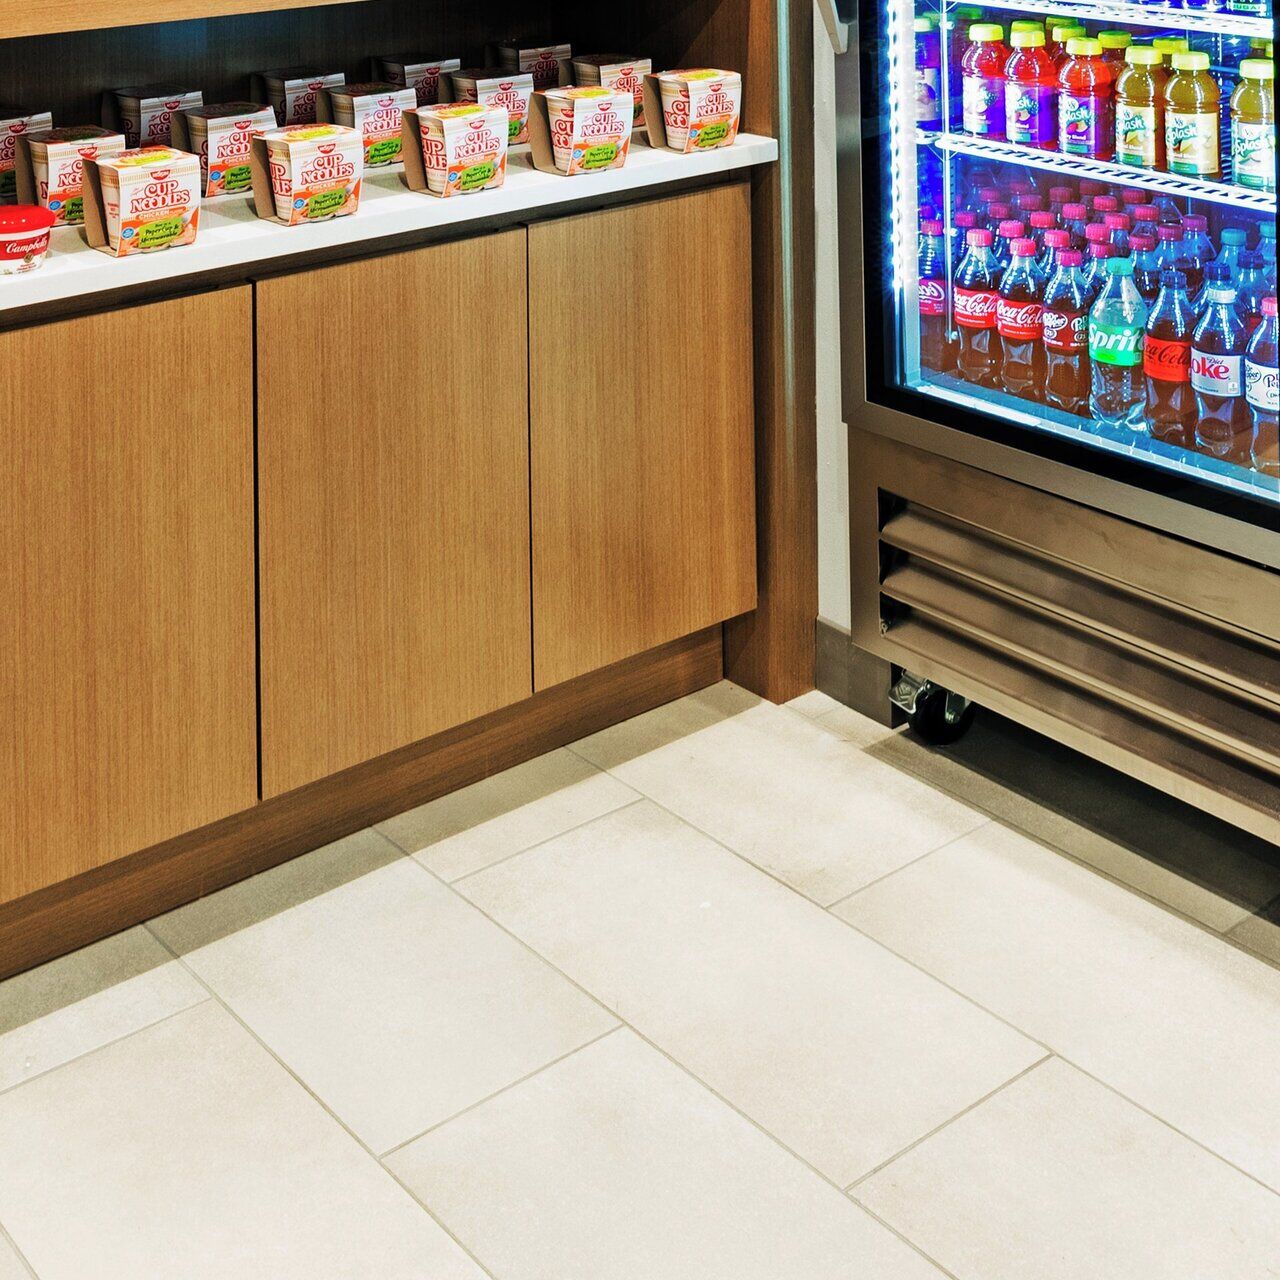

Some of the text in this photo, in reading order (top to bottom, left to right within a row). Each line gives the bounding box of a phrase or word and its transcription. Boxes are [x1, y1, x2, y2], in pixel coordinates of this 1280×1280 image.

[616, 75, 638, 88] CUP
[494, 90, 518, 104] CUP
[705, 92, 727, 104] CUP
[373, 107, 400, 121] CUP
[696, 100, 734, 118] NOODLES
[592, 111, 617, 124] CUP
[465, 129, 492, 144] CUP
[581, 121, 624, 138] NOODLES
[229, 132, 249, 144] CU
[217, 143, 251, 159] NOOD
[454, 137, 500, 159] NOODLES
[313, 154, 344, 170] CUP
[301, 162, 355, 186] NOODLES
[144, 180, 178, 198] CUP
[130, 189, 191, 213] NOODLES
[138, 210, 169, 220] CHICKEN
[6, 236, 48, 253] Campbell's
[1191, 356, 1231, 380] oke
[1207, 355, 1224, 365] Diet
